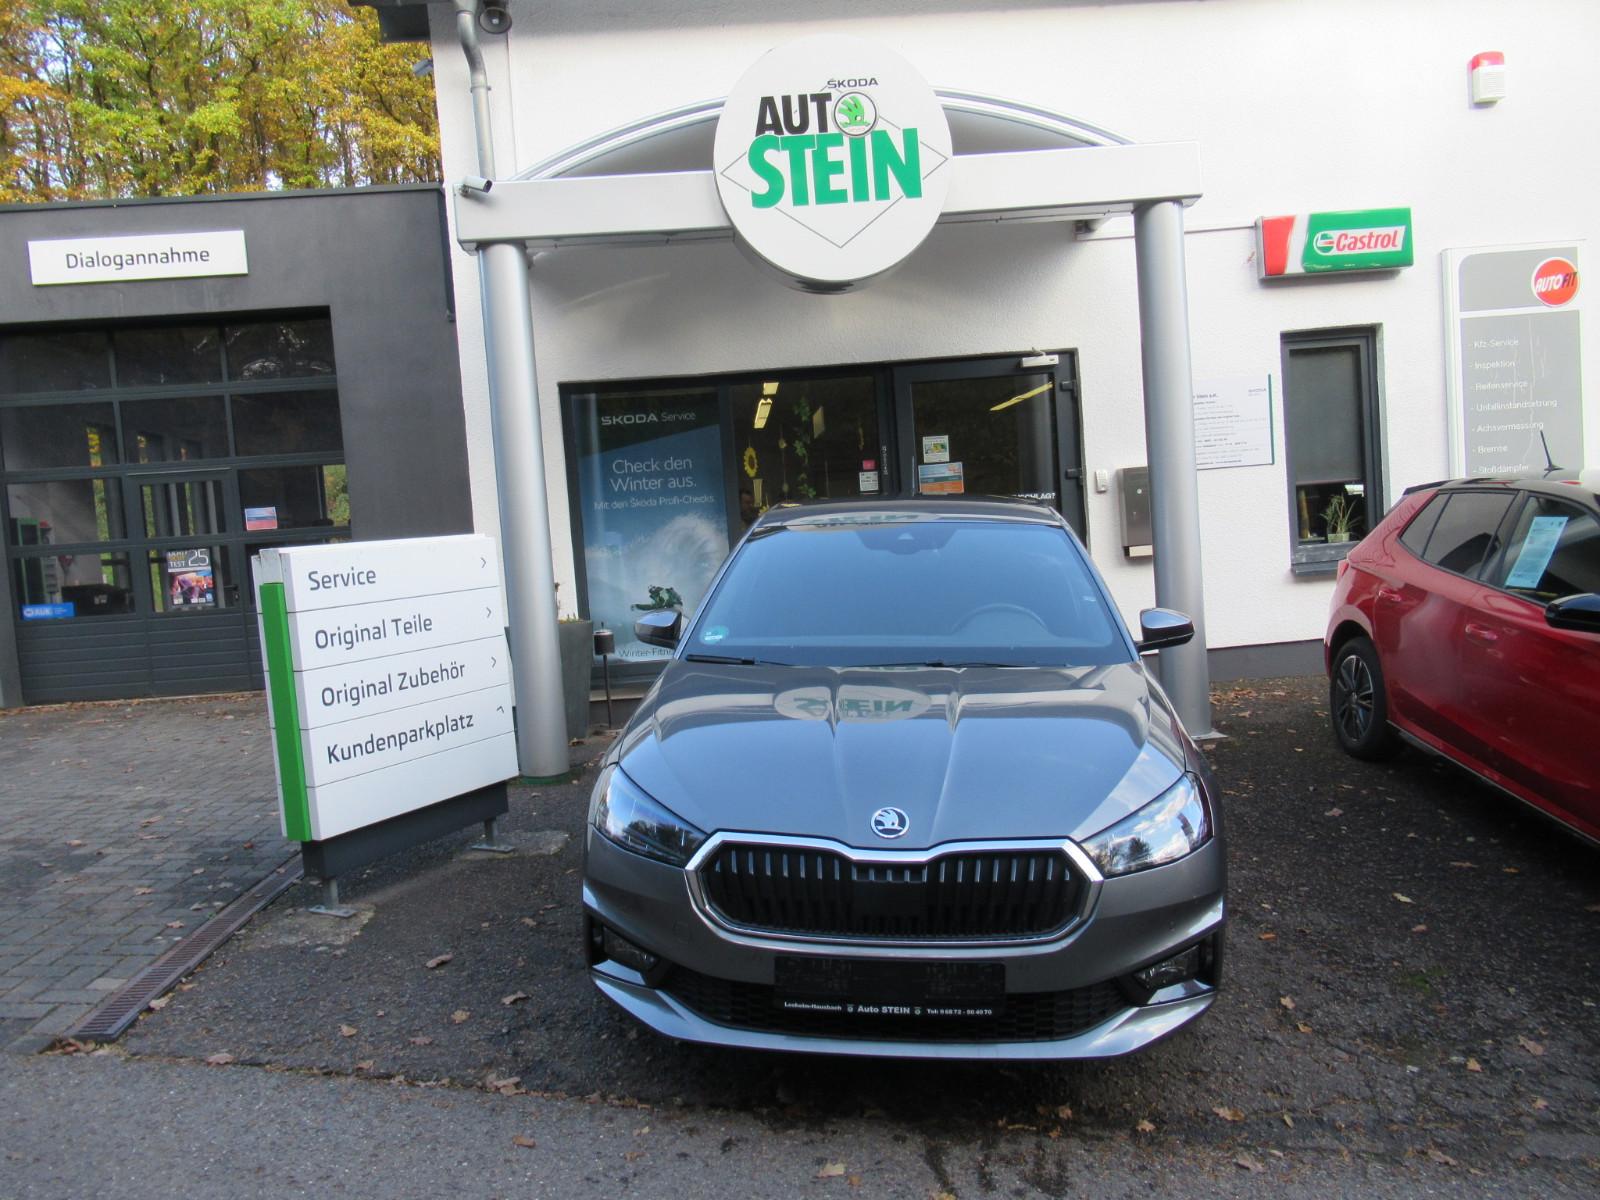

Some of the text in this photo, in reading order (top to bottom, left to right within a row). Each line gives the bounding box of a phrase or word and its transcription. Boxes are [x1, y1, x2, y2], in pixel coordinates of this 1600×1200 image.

[748, 128, 923, 209] STEIN
[1335, 229, 1398, 252] Castrol
[65, 247, 210, 270] Dialogannahme
[1473, 339, 1520, 349] Kfz-Service
[1474, 360, 1516, 371] Inspektion
[661, 411, 697, 422] Service
[612, 456, 693, 474] Check den
[609, 476, 664, 492] Winter
[611, 500, 628, 509] den
[308, 566, 377, 591] Service
[315, 613, 433, 650] Original Teile
[321, 661, 466, 706] Original Zubehör
[326, 713, 475, 764] Kundenparkplatz
[858, 1004, 879, 1013] Auto
[881, 1006, 911, 1015] STEIN
